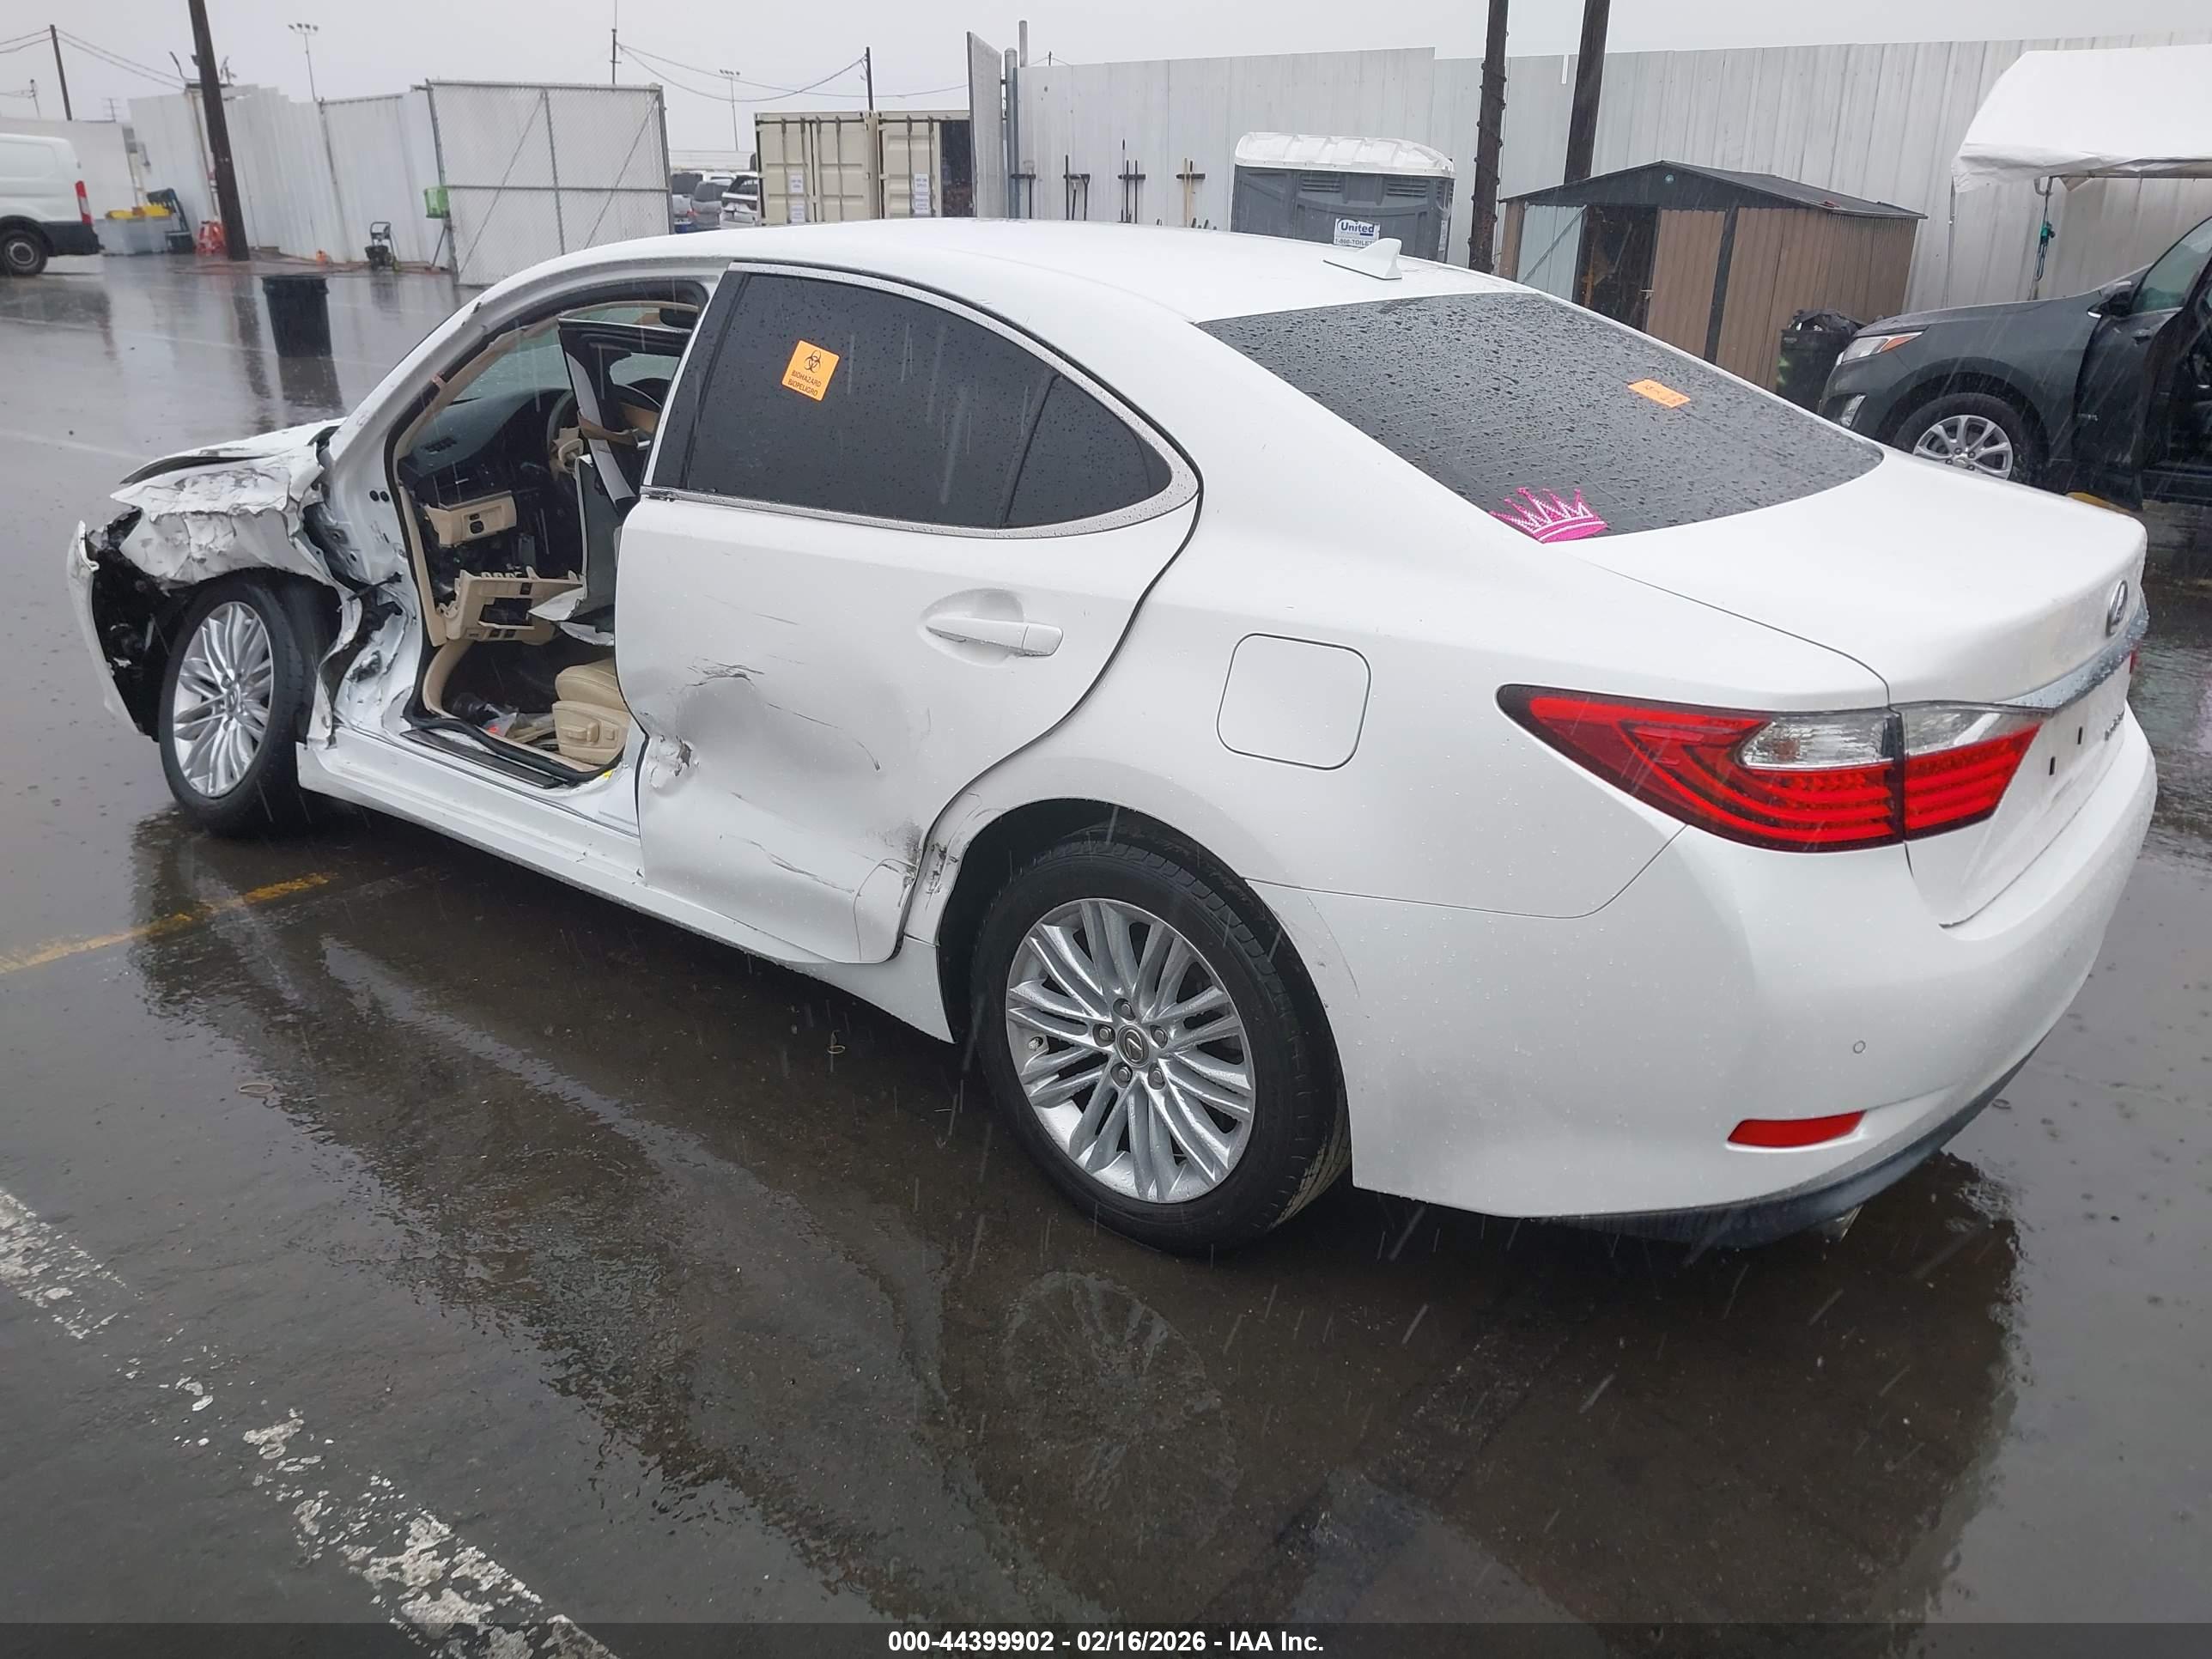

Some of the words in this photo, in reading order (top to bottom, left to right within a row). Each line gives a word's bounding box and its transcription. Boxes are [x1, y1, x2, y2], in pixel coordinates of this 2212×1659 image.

[1341, 222, 1374, 233] United
[787, 378, 818, 396] BIOPELIGRO
[792, 369, 822, 387] BIOHAZARD
